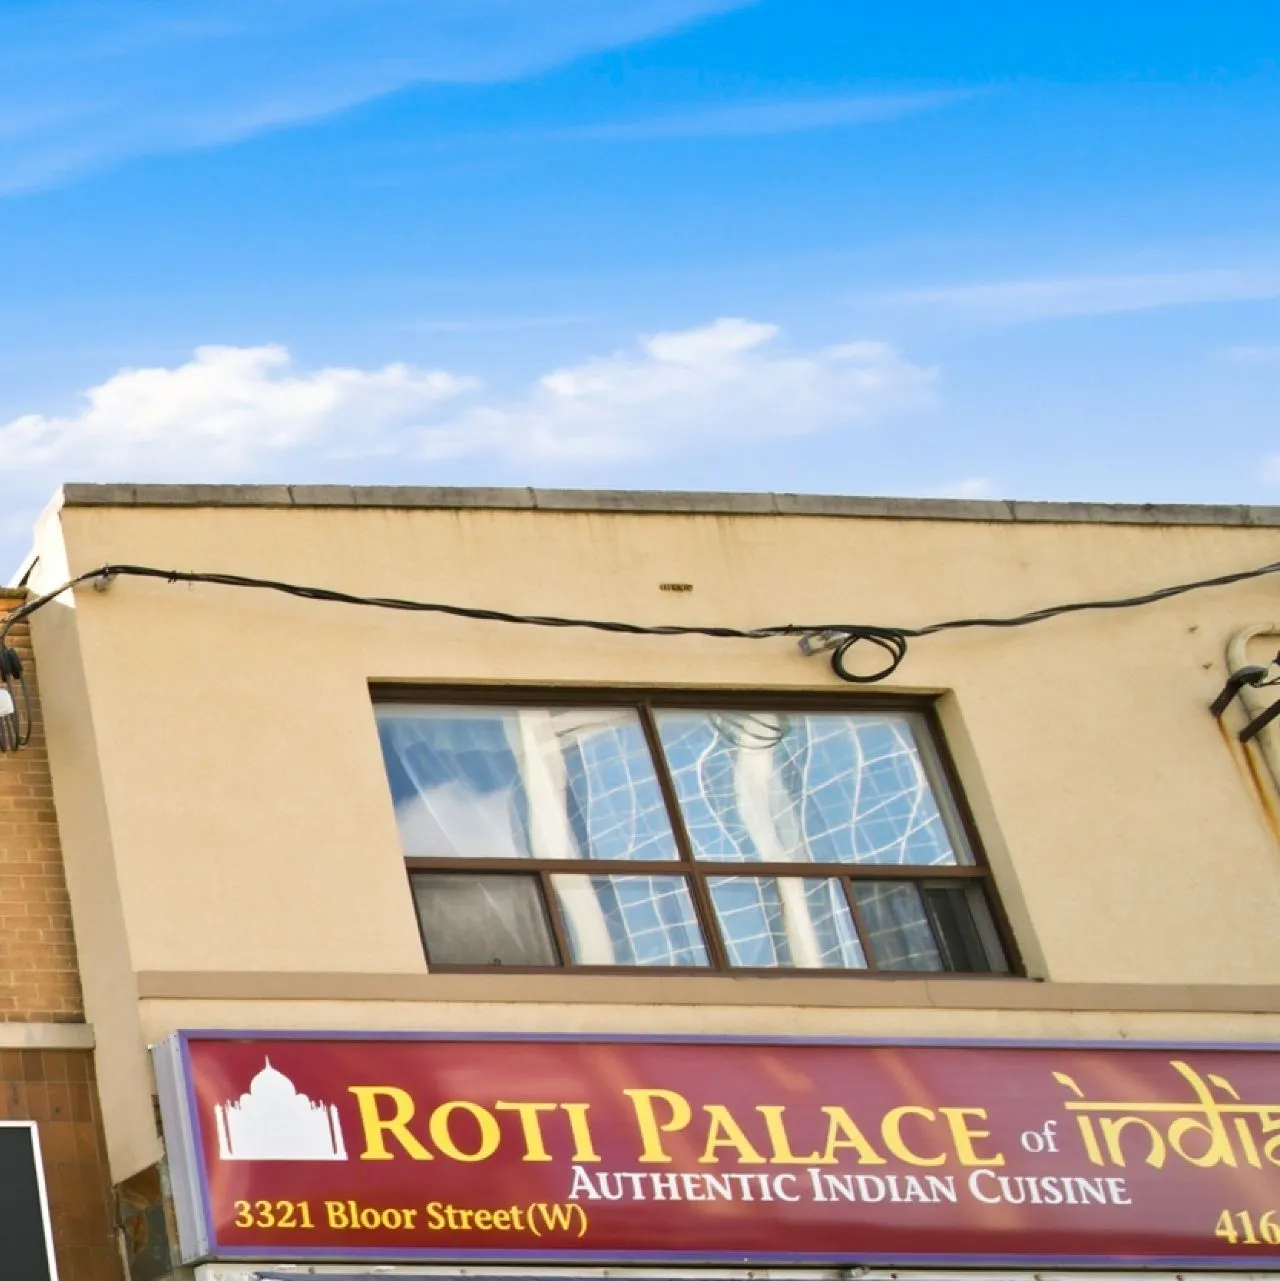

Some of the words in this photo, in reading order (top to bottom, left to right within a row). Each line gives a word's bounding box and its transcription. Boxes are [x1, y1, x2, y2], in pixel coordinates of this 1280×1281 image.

[348, 1086, 601, 1162] ROTI
[624, 1089, 1005, 1167] PALACE
[1021, 1120, 1057, 1153] of
[569, 1166, 798, 1202] AUTHENTIC
[811, 1168, 956, 1203] INDIAN
[968, 1169, 1132, 1205] CUISINE
[234, 1201, 314, 1228] 3321
[327, 1201, 416, 1230] Bloor
[1215, 1208, 1280, 1244] 416
